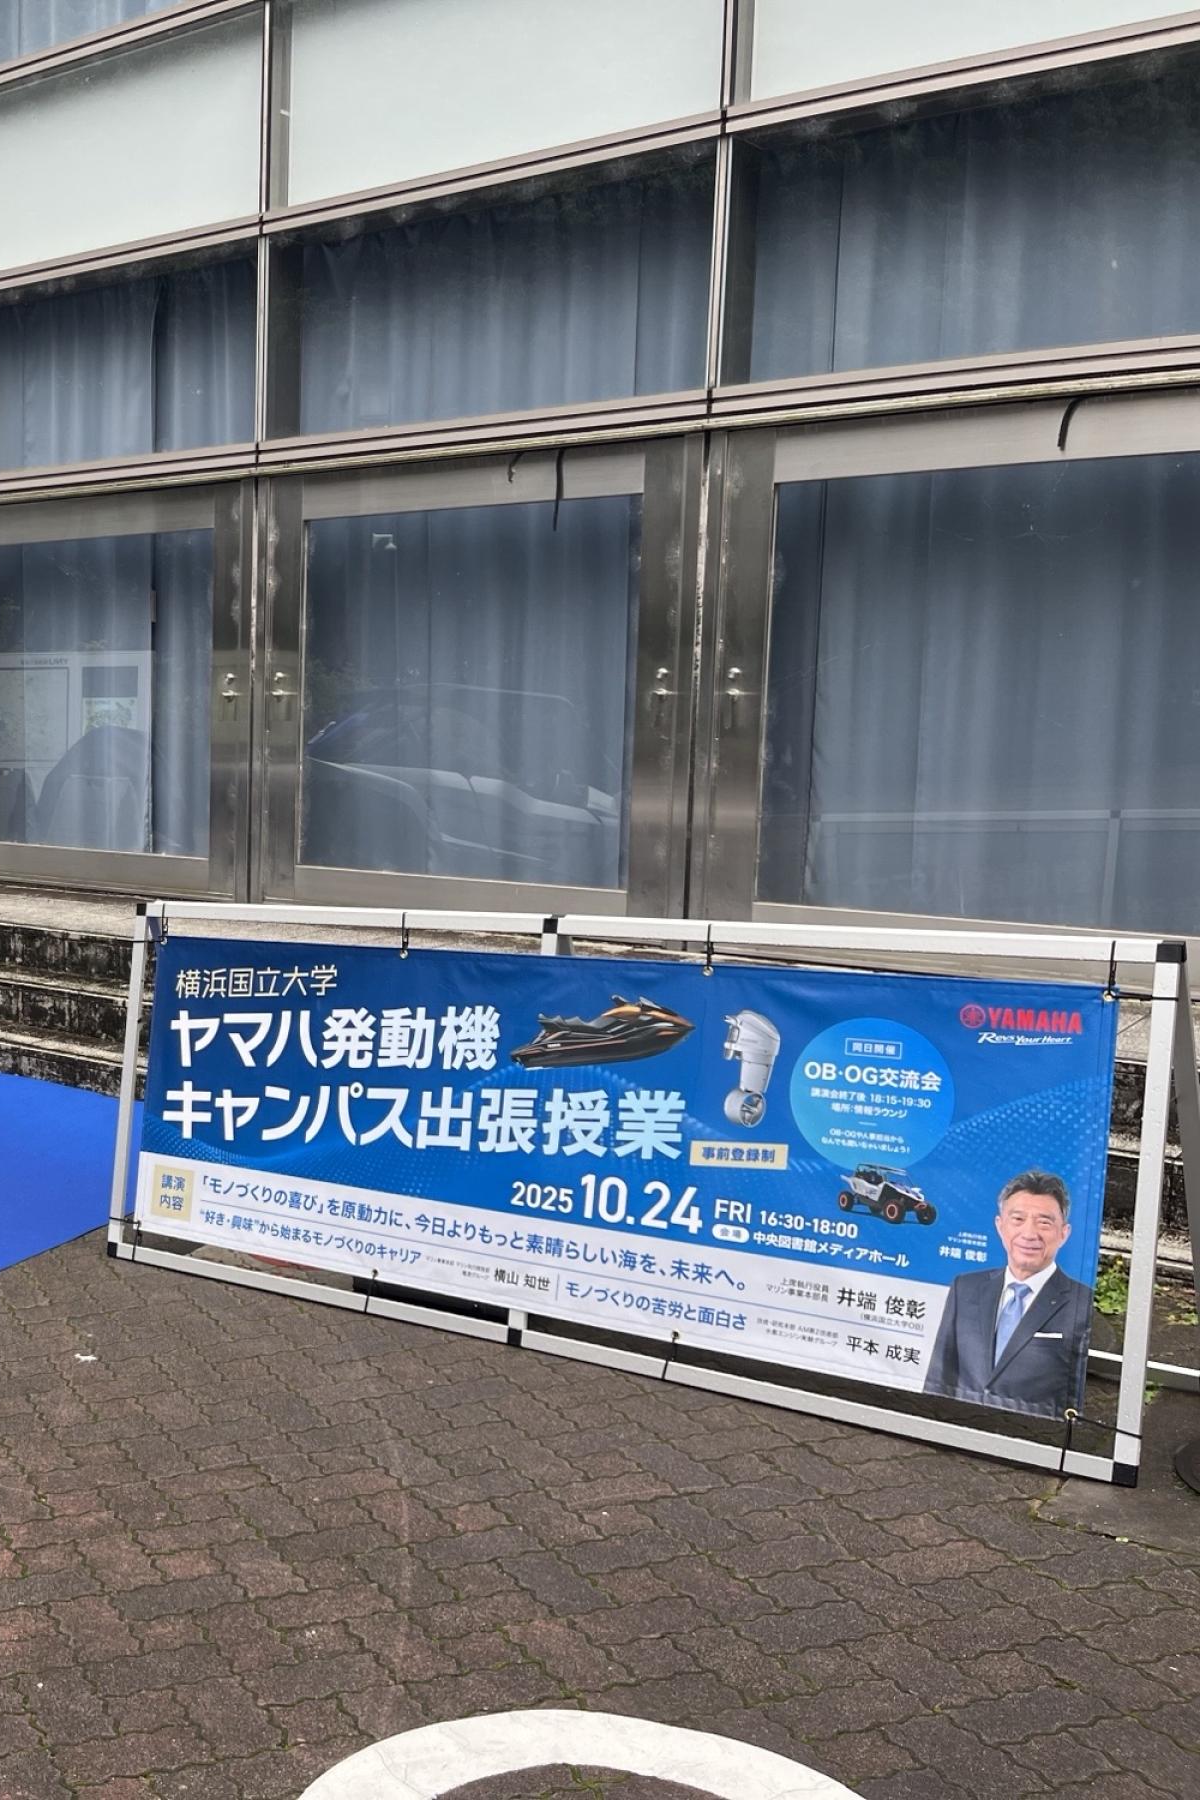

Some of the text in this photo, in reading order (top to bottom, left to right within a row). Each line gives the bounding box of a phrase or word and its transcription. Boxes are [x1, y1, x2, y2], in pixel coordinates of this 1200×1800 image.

[175, 964, 338, 999] 横浜国立大学
[987, 1007, 1082, 1034] YAMAHA
[170, 1005, 501, 1071] ヤマハ発動機
[978, 1031, 1015, 1044] Revs
[1014, 1035, 1041, 1045] Your
[810, 1087, 931, 1109] 講演会終了後 18:15-19:30
[162, 1081, 686, 1160] キャンパス出張授業
[702, 1146, 776, 1164] 事前登録制
[161, 1173, 186, 1191] 講演
[159, 1194, 185, 1211] 内容
[510, 1173, 858, 1239] 2025 10.24 FRI 16:30-18:00
[719, 1227, 910, 1268] 会場 中央図書館メディアホール
[493, 1267, 520, 1286] 横山
[523, 1273, 551, 1292] 知世
[565, 1280, 748, 1331] モノづくりの苦労と面白さ
[837, 1286, 926, 1320] 井端 俊彰
[845, 1334, 921, 1366] 平本 成実
